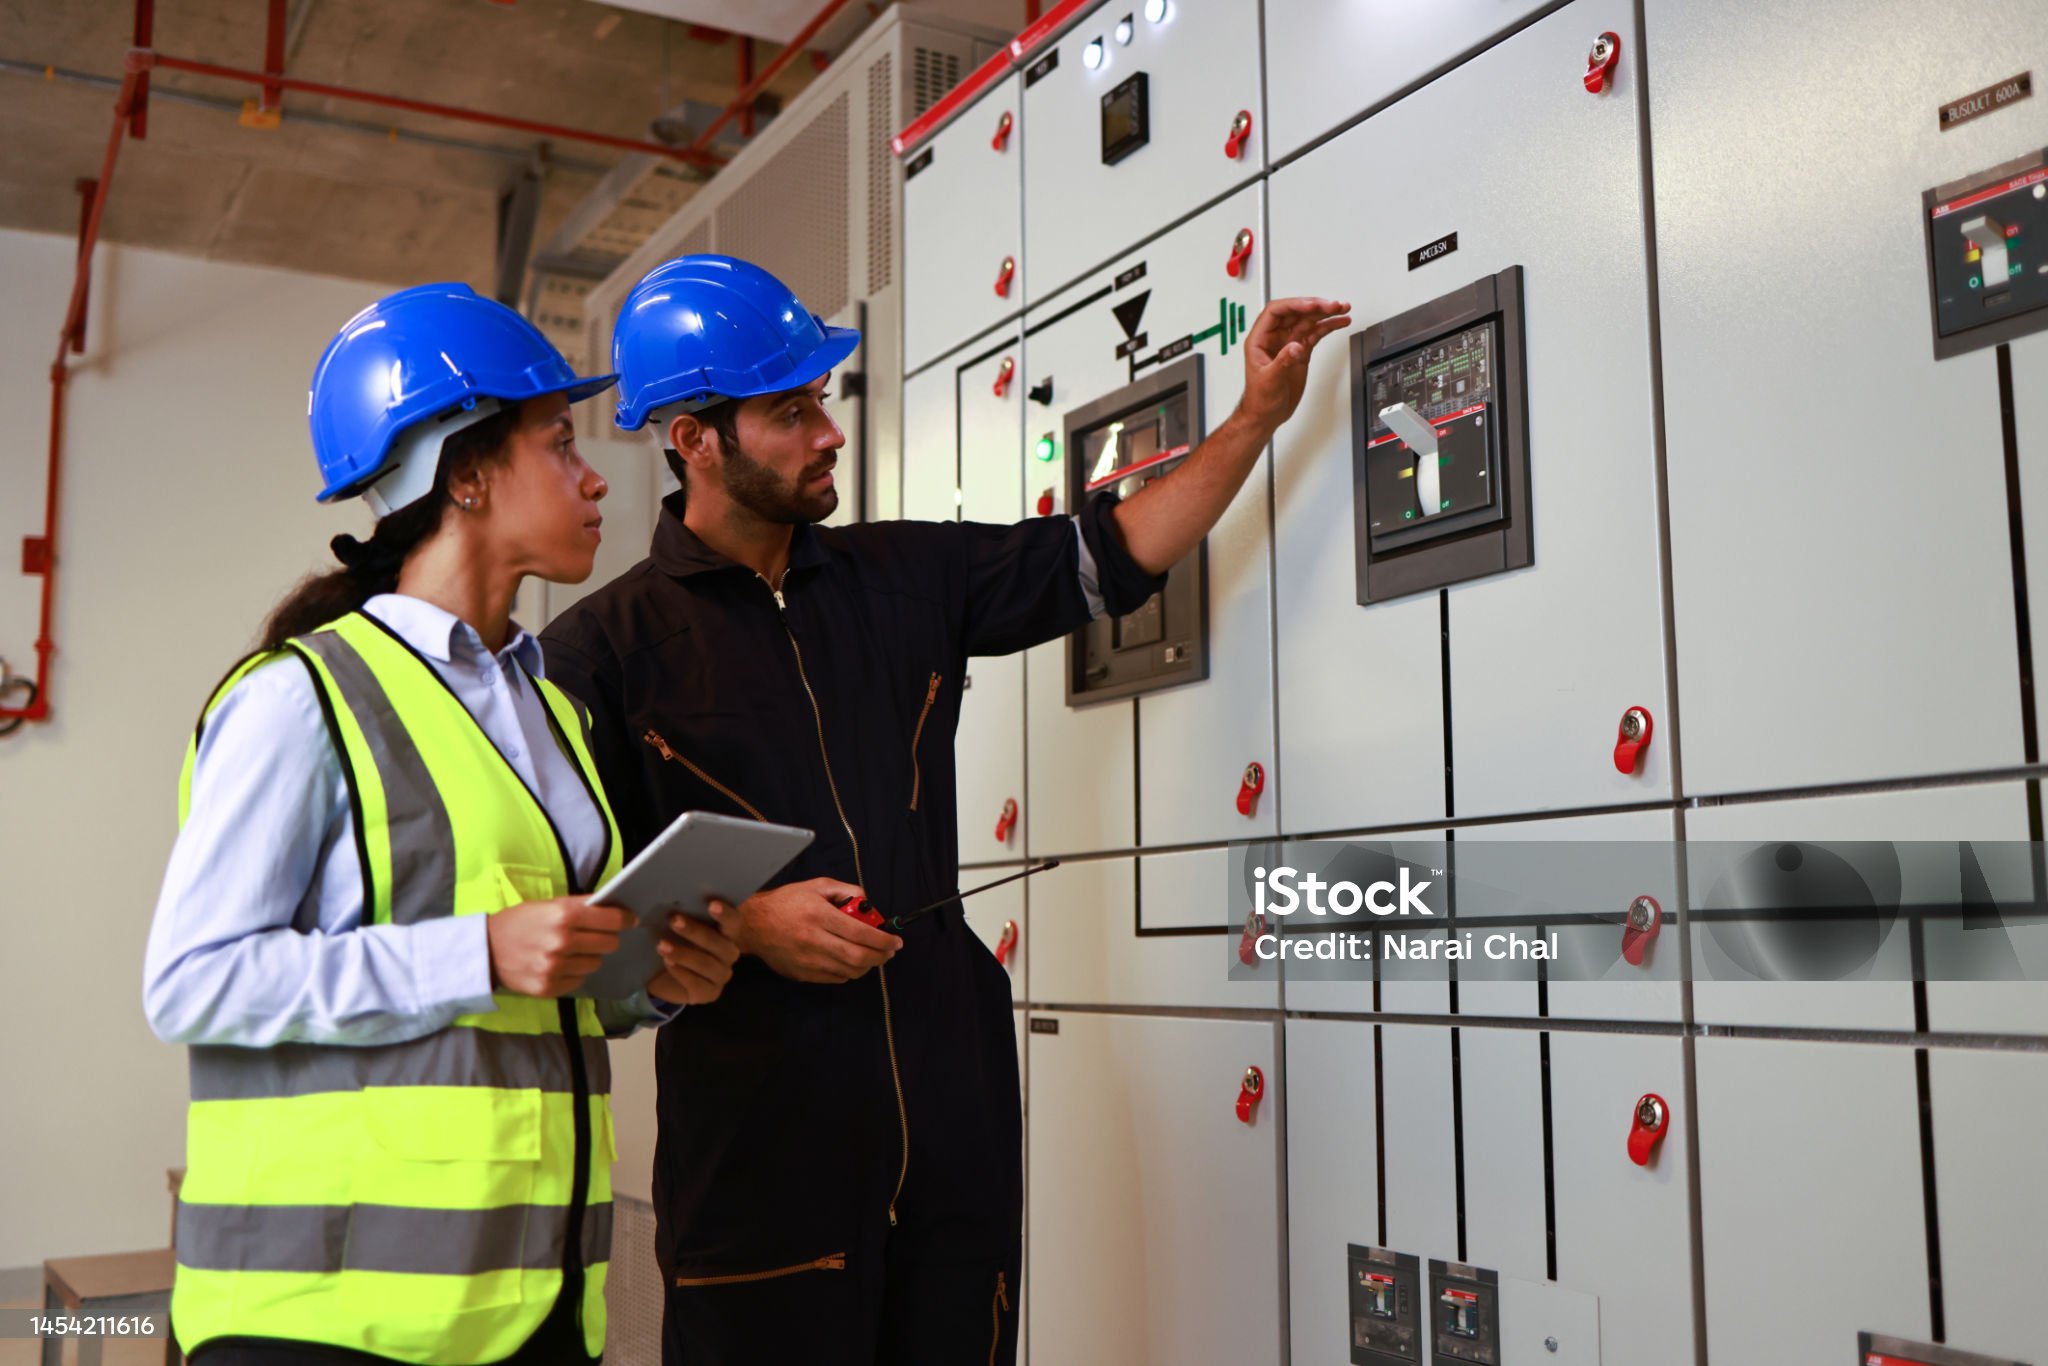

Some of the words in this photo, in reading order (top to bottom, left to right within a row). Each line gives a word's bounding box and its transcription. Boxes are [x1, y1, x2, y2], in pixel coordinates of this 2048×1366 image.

[1948, 95, 1990, 122] BUSDUCT
[1995, 82, 2021, 103] 600A
[1935, 204, 1950, 215] ABB
[2009, 262, 2022, 275] off
